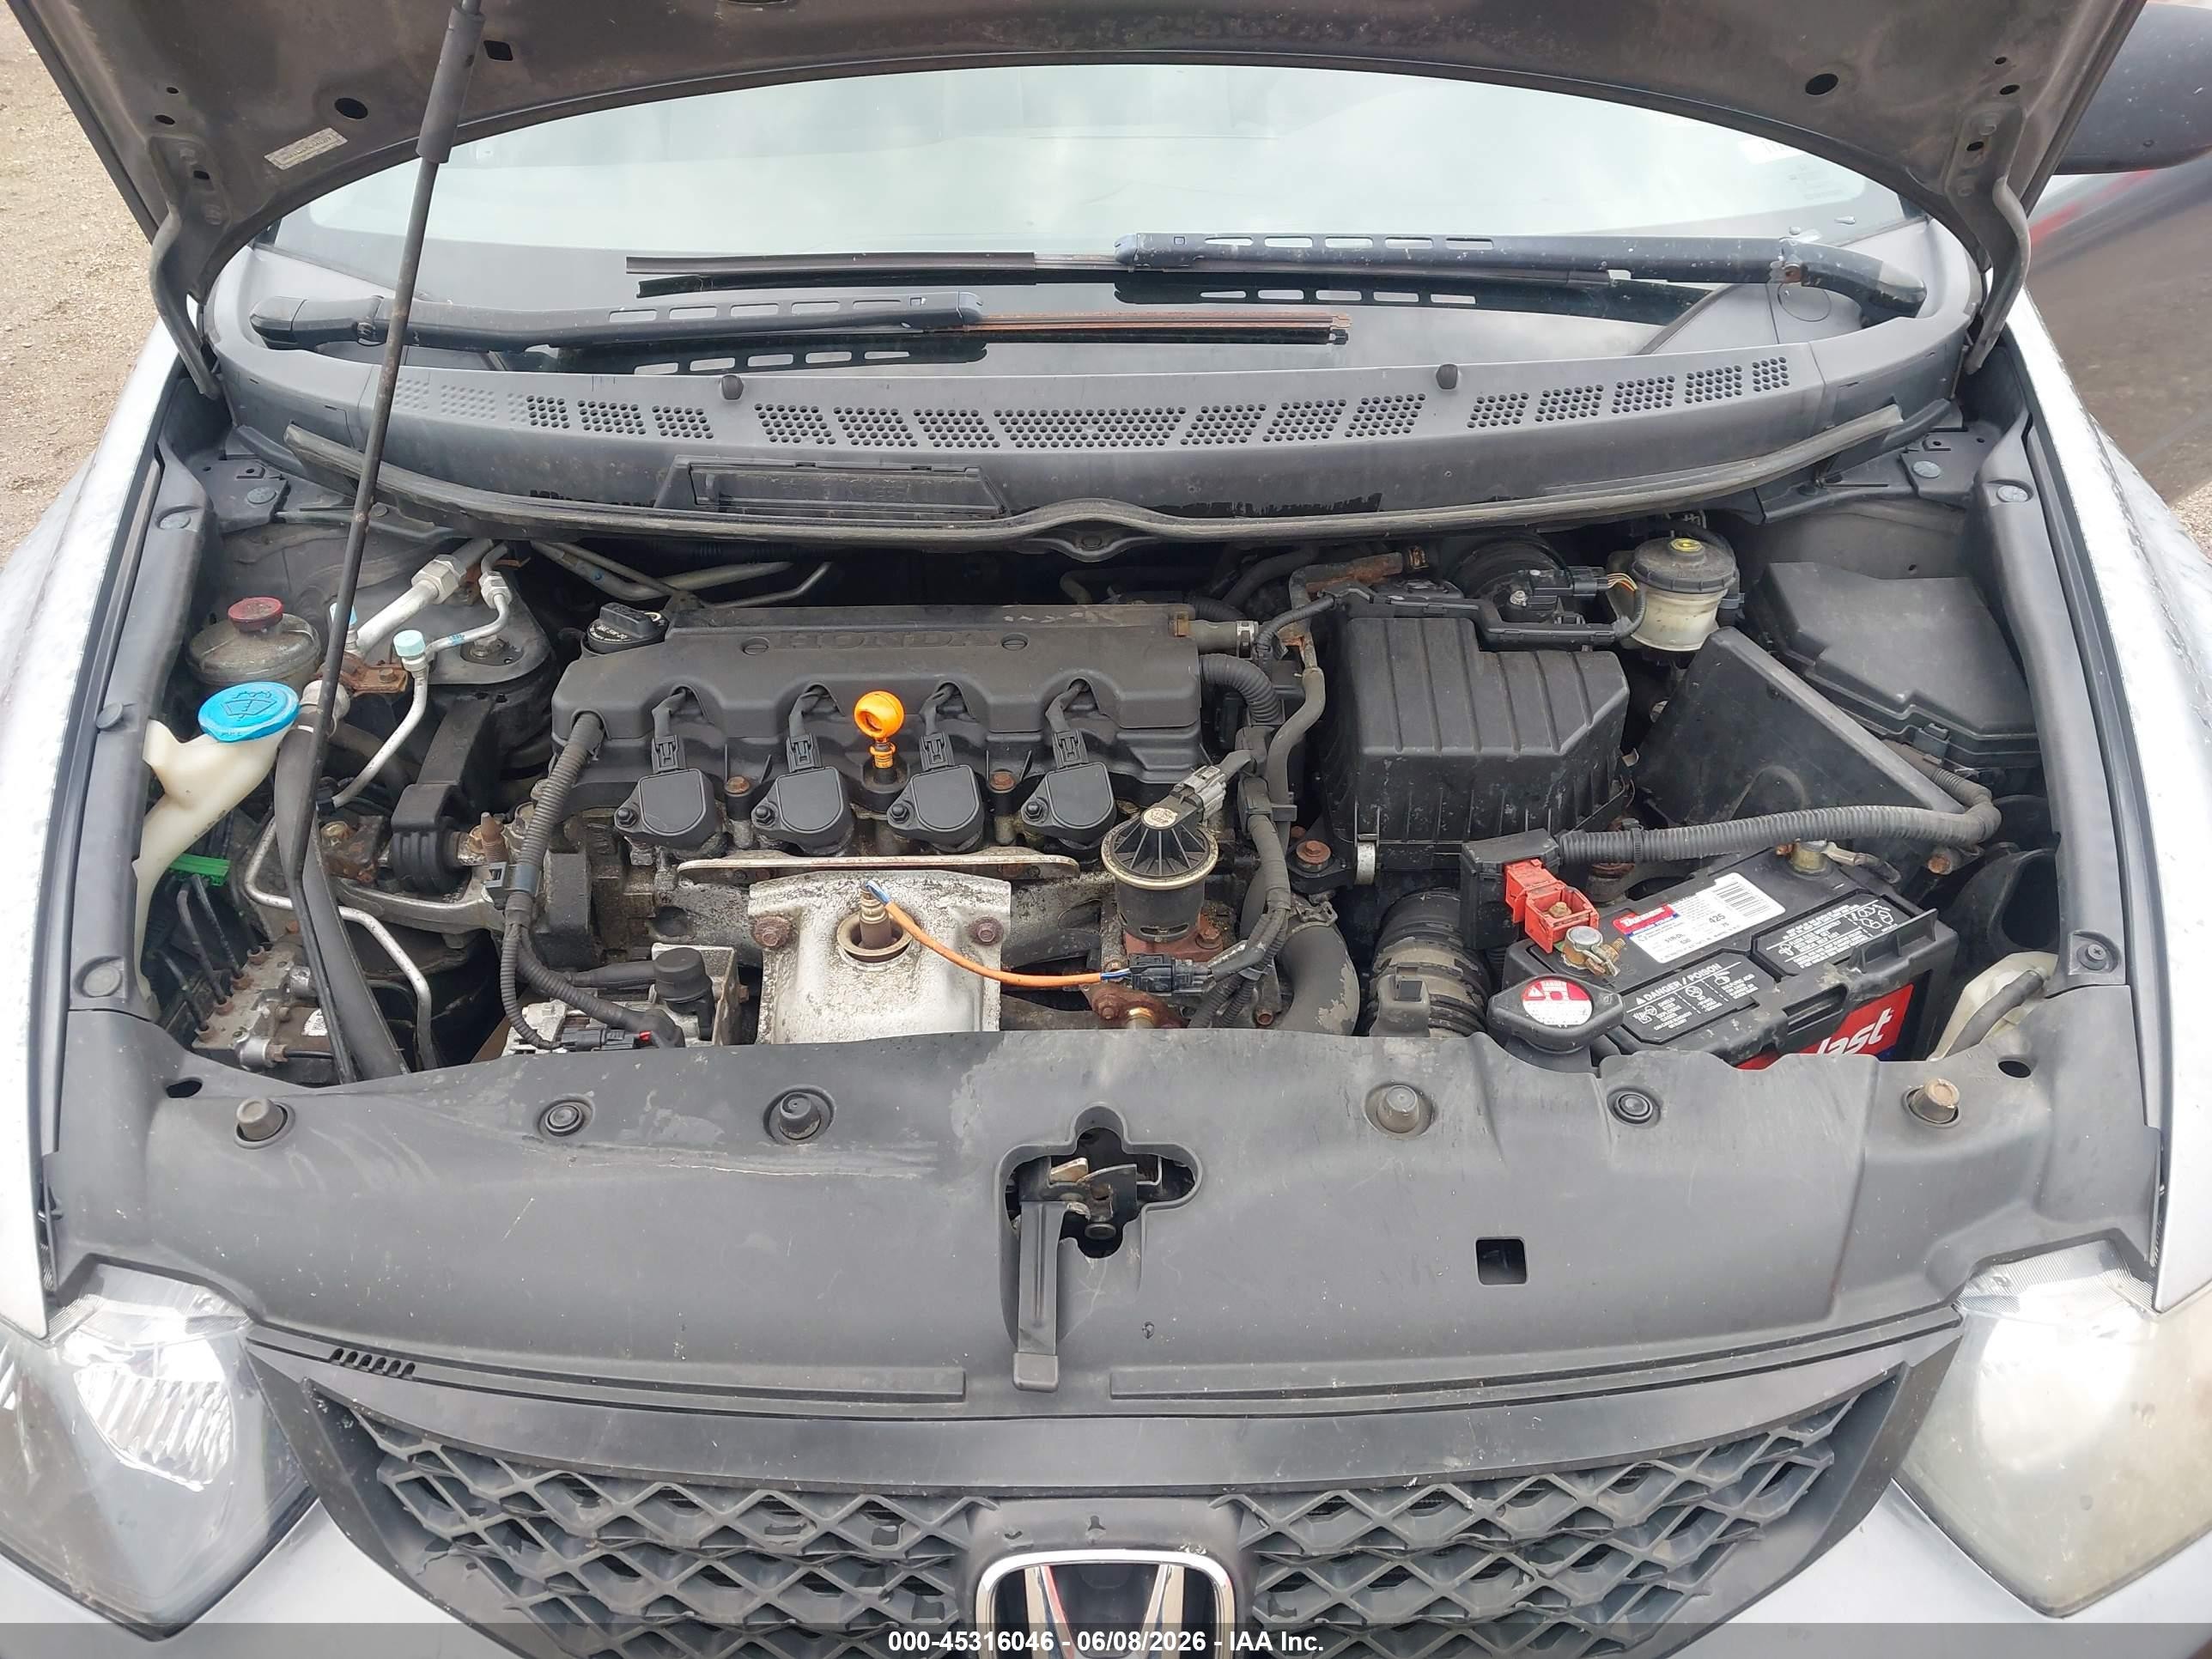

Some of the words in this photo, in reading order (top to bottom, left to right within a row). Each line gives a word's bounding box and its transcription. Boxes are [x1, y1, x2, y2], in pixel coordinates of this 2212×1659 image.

[774, 631, 997, 649] HONDA
[1708, 912, 1726, 924] 425
[1643, 981, 1682, 1001] DANGER
[1687, 963, 1723, 981] POISON
